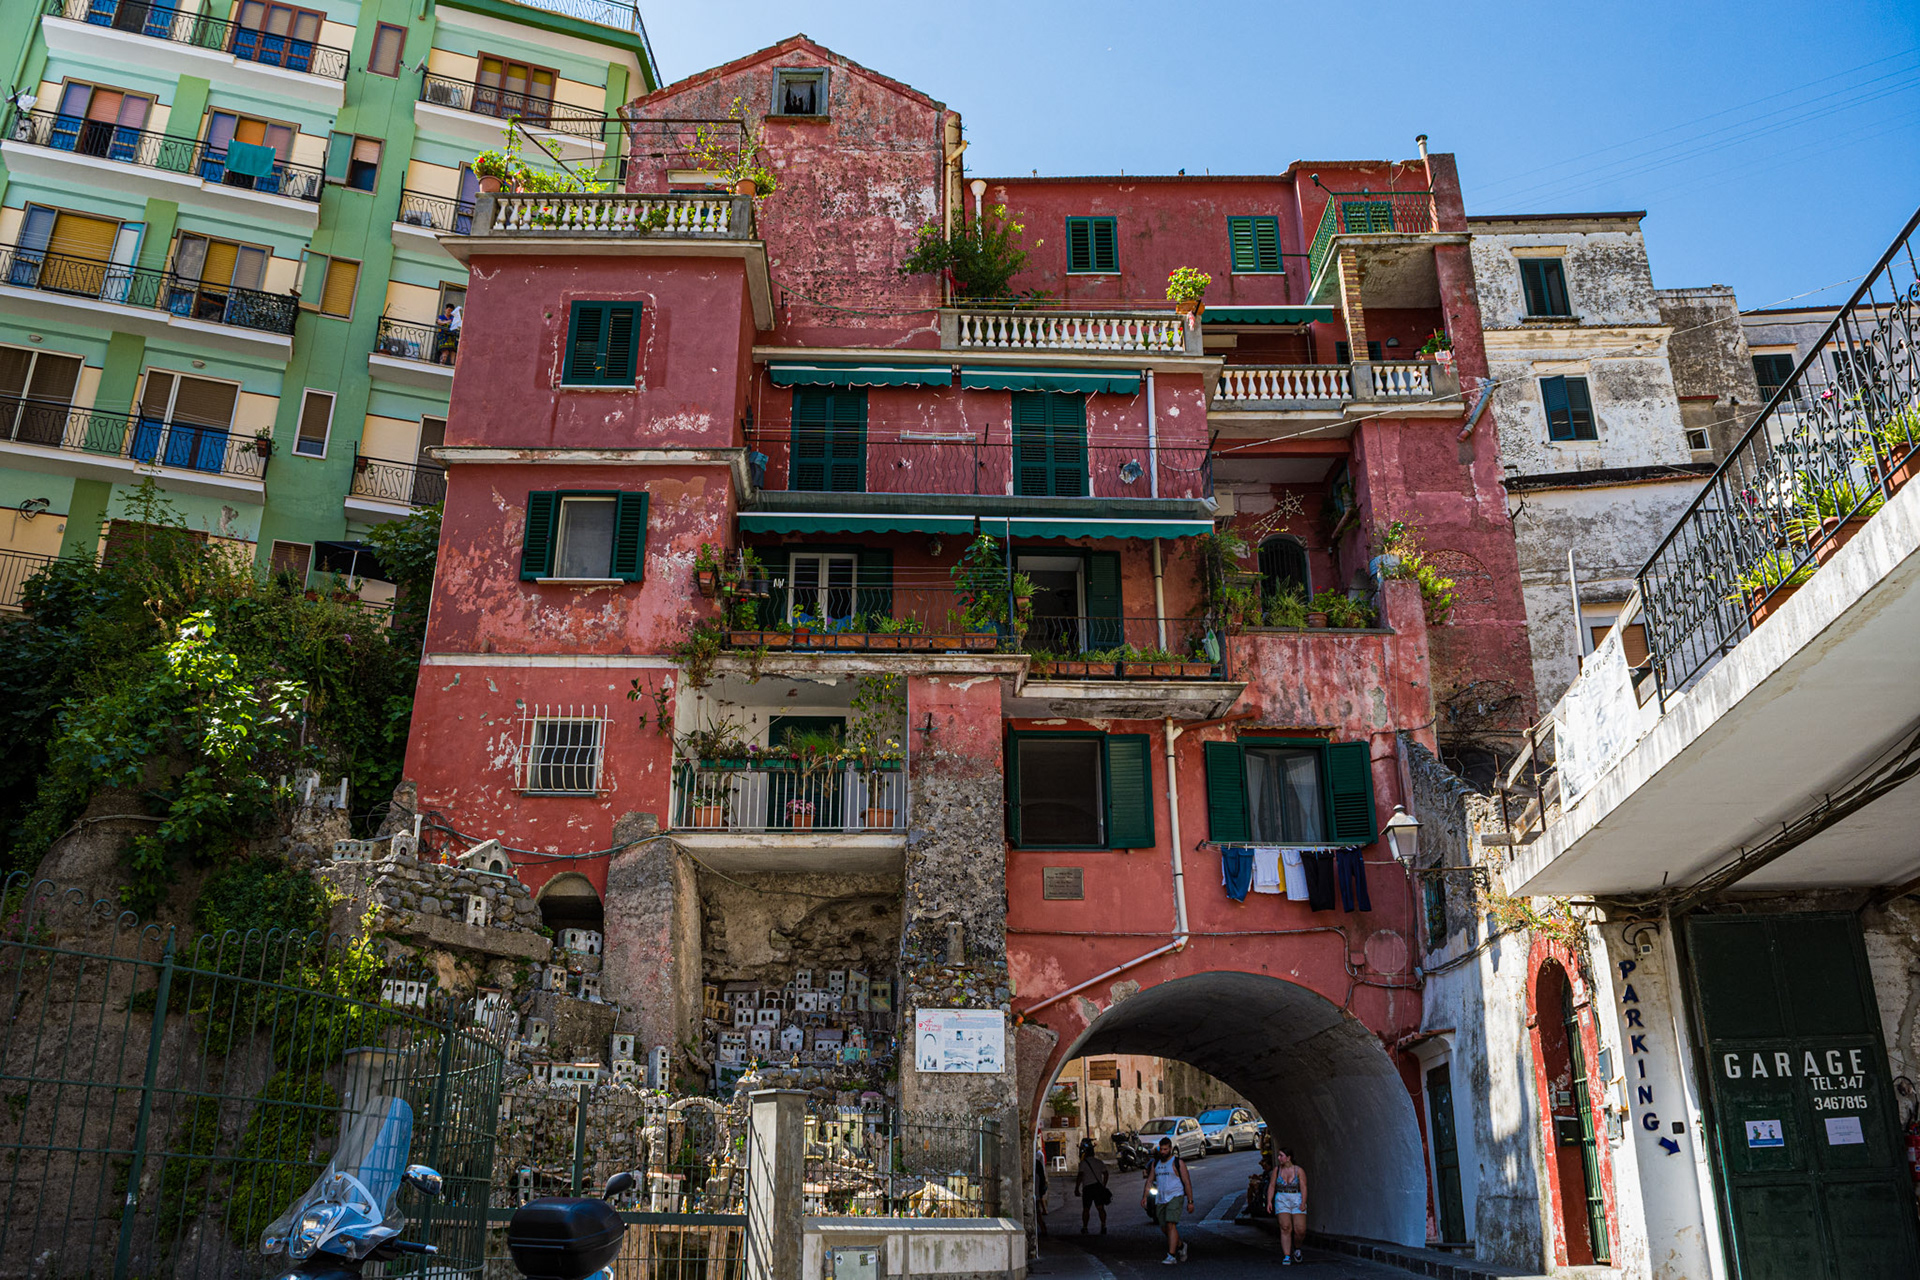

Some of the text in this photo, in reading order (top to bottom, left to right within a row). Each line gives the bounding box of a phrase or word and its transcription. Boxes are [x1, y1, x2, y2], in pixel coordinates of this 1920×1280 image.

[1618, 959, 1660, 1131] PARKING
[1724, 1049, 1866, 1079] GARAGE
[1810, 1075, 1864, 1091] TEL. 347
[1813, 1095, 1868, 1111] 3467815
